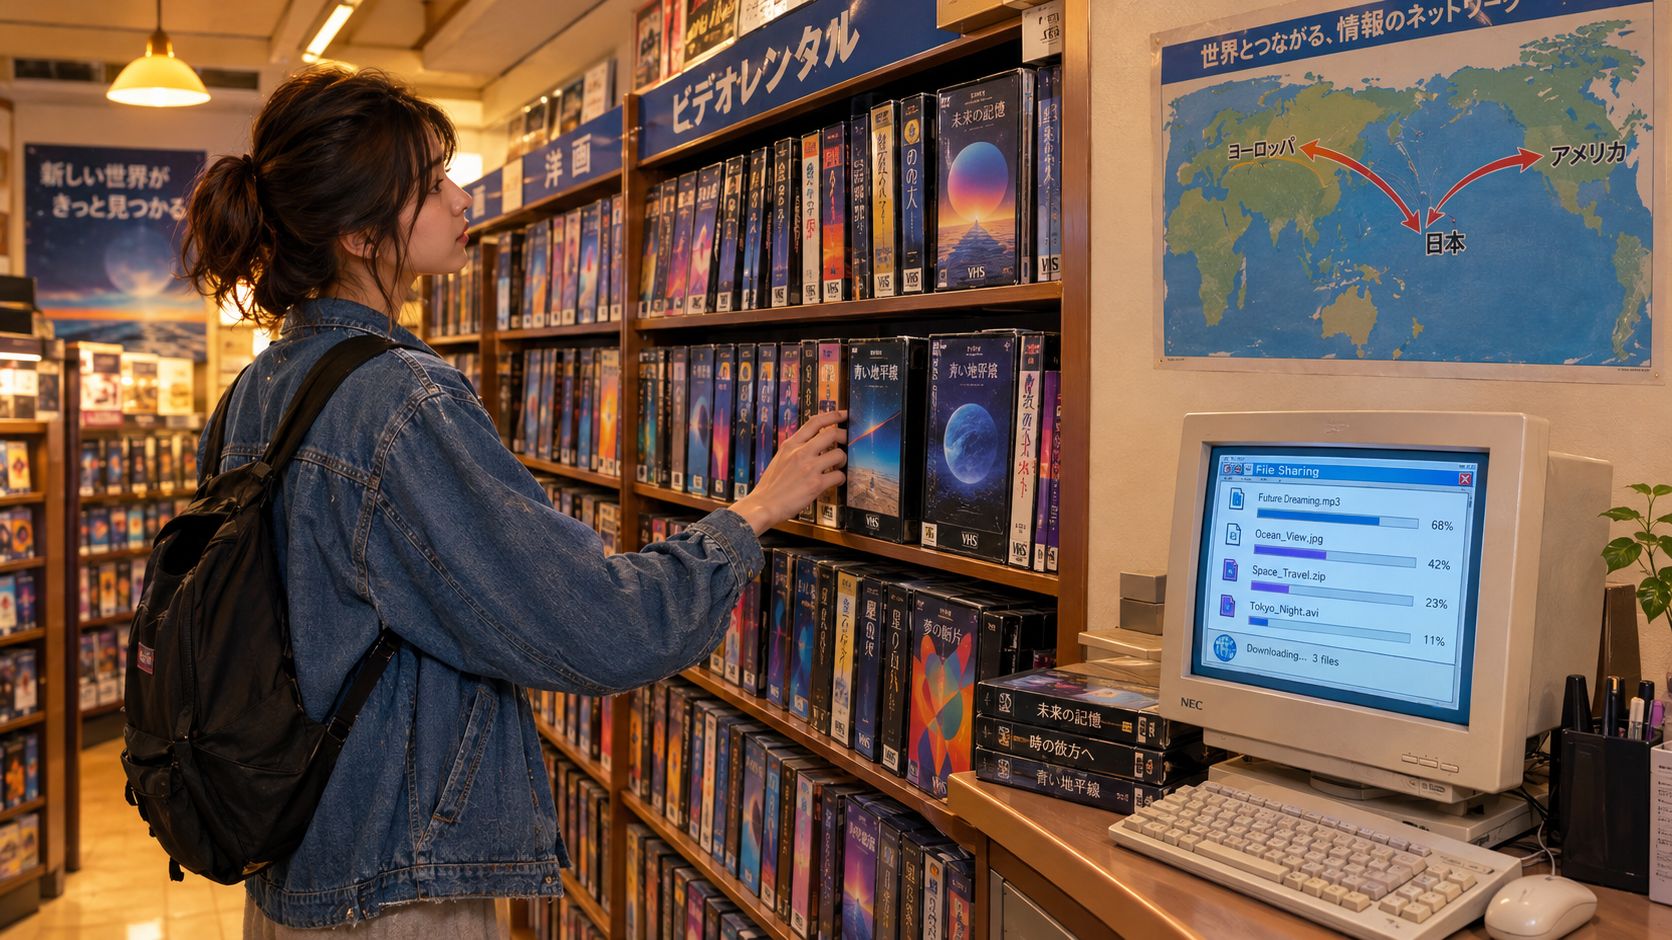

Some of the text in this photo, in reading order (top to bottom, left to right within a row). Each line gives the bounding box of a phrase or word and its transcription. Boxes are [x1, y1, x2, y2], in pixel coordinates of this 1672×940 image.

[673, 10, 860, 134] ビデオレンタル
[1228, 136, 1296, 160] ヨーロッパ
[1550, 141, 1626, 167] アメリカ
[544, 133, 592, 189] 洋画
[40, 160, 170, 190] 新しい世界が
[52, 193, 187, 220] きっと見つかる
[1426, 231, 1465, 255] 日本
[968, 266, 985, 278] VHS
[1256, 464, 1319, 478] File Sharing
[1258, 493, 1341, 507] Future Dreaming.mp3
[865, 514, 879, 528] VHS
[1431, 519, 1453, 532] 68%
[961, 532, 978, 547] VHS
[1255, 529, 1323, 545] Ocean_View.jpg
[1428, 558, 1451, 571] 42%
[1252, 565, 1326, 583] Space_Travel.zip
[1250, 601, 1319, 618] Tokyo_Night.avi
[1425, 598, 1448, 610] 23%
[1424, 635, 1445, 647] 11%
[1247, 643, 1340, 667] Downloading... 3 files
[1181, 697, 1204, 710] NEC
[1037, 702, 1102, 728] 未来の記憶
[1036, 769, 1101, 799] 青い地平線
